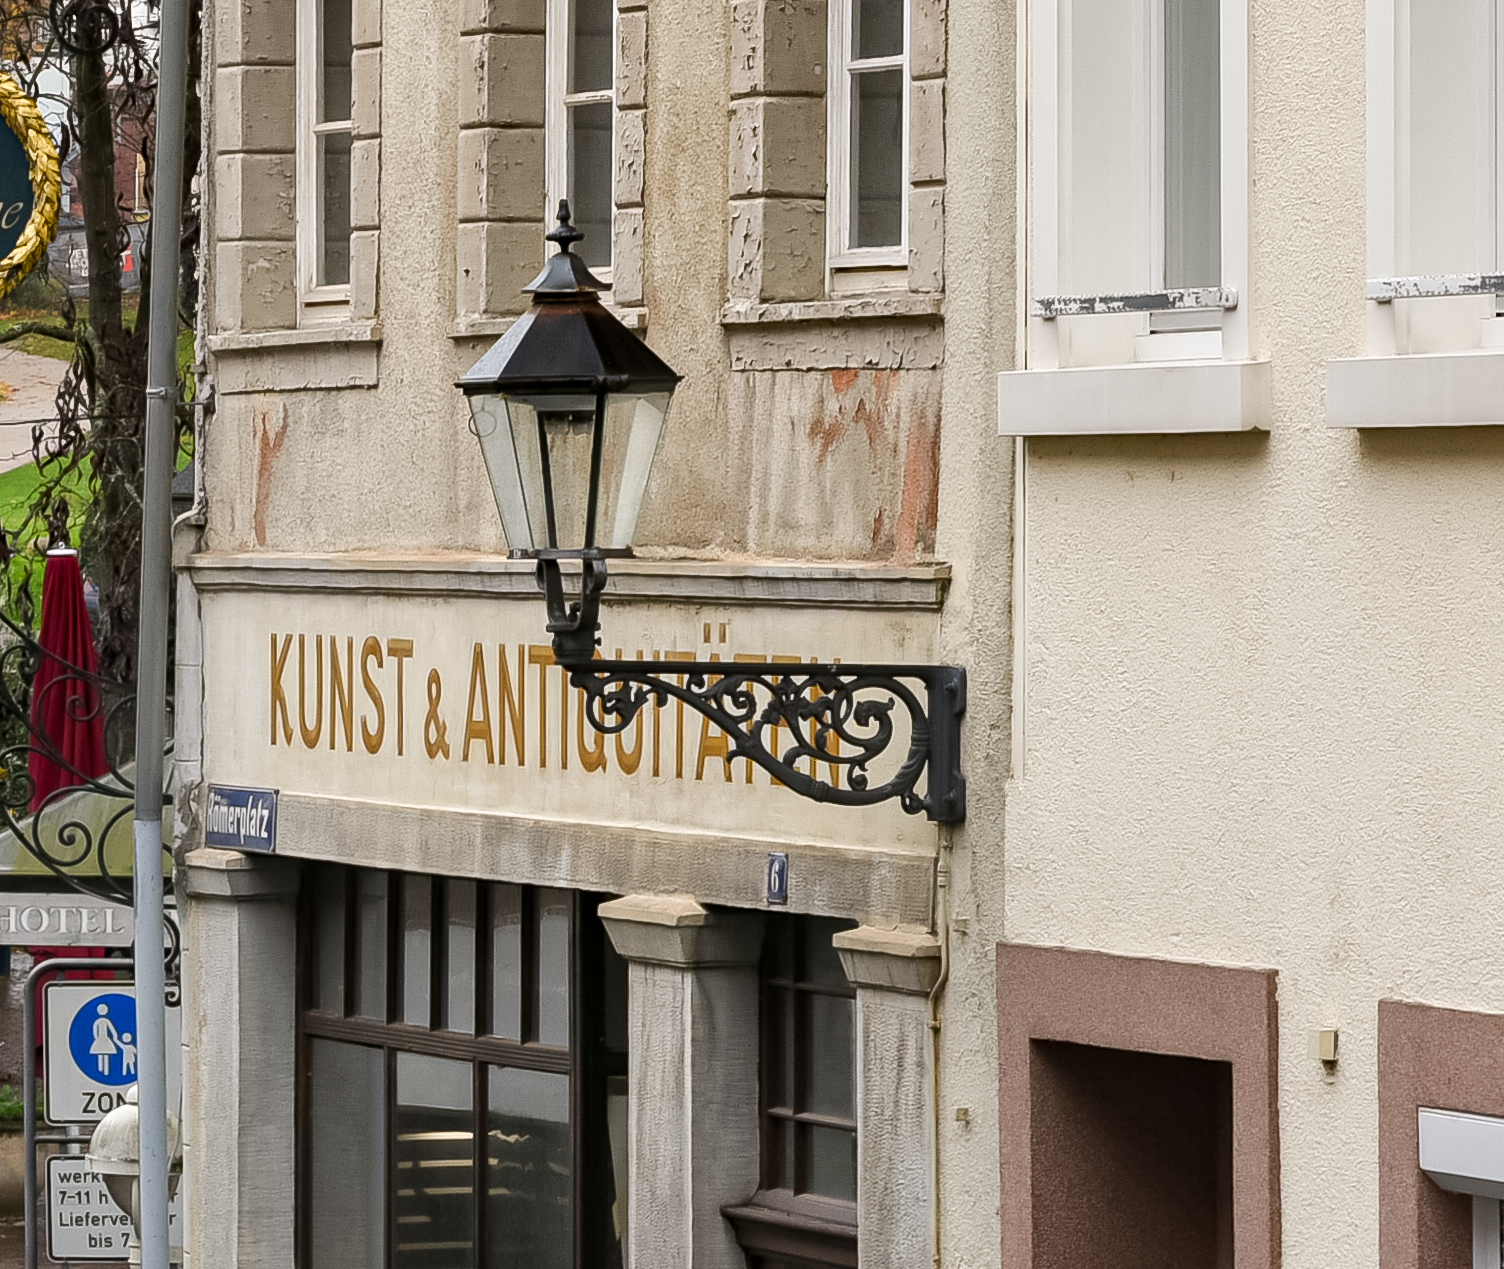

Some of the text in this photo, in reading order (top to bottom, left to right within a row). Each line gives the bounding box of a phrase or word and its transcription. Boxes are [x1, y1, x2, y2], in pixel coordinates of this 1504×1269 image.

[270, 633, 414, 757] KUNST
[423, 668, 451, 760] &
[207, 791, 270, 845] Römerplatz
[770, 860, 780, 893] 6
[98, 1190, 109, 1205] h
[88, 1233, 113, 1248] bis
